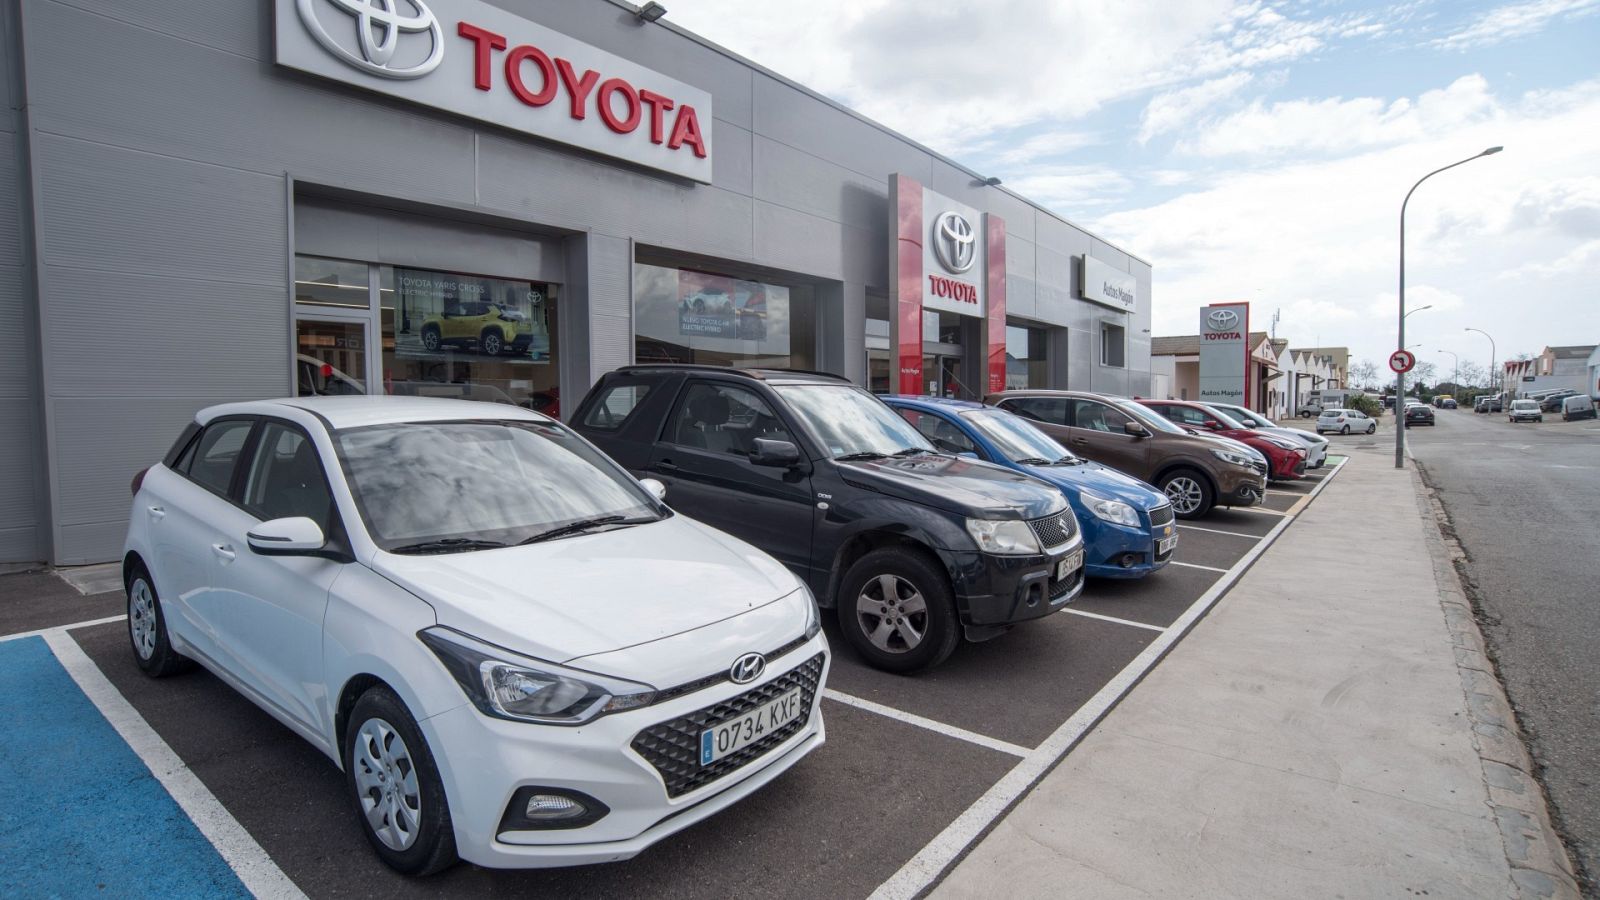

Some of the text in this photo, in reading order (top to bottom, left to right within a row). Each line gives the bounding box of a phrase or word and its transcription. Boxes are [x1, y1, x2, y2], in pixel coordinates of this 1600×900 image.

[457, 21, 707, 159] TOYOTA
[399, 276, 485, 294] TOYOTA YARIS CROSS
[928, 274, 978, 305] TOYOTA
[1103, 281, 1118, 300] Autos
[1204, 332, 1241, 340] TOYOTA
[718, 693, 797, 753] 0734 KXF
[704, 750, 711, 758] E
